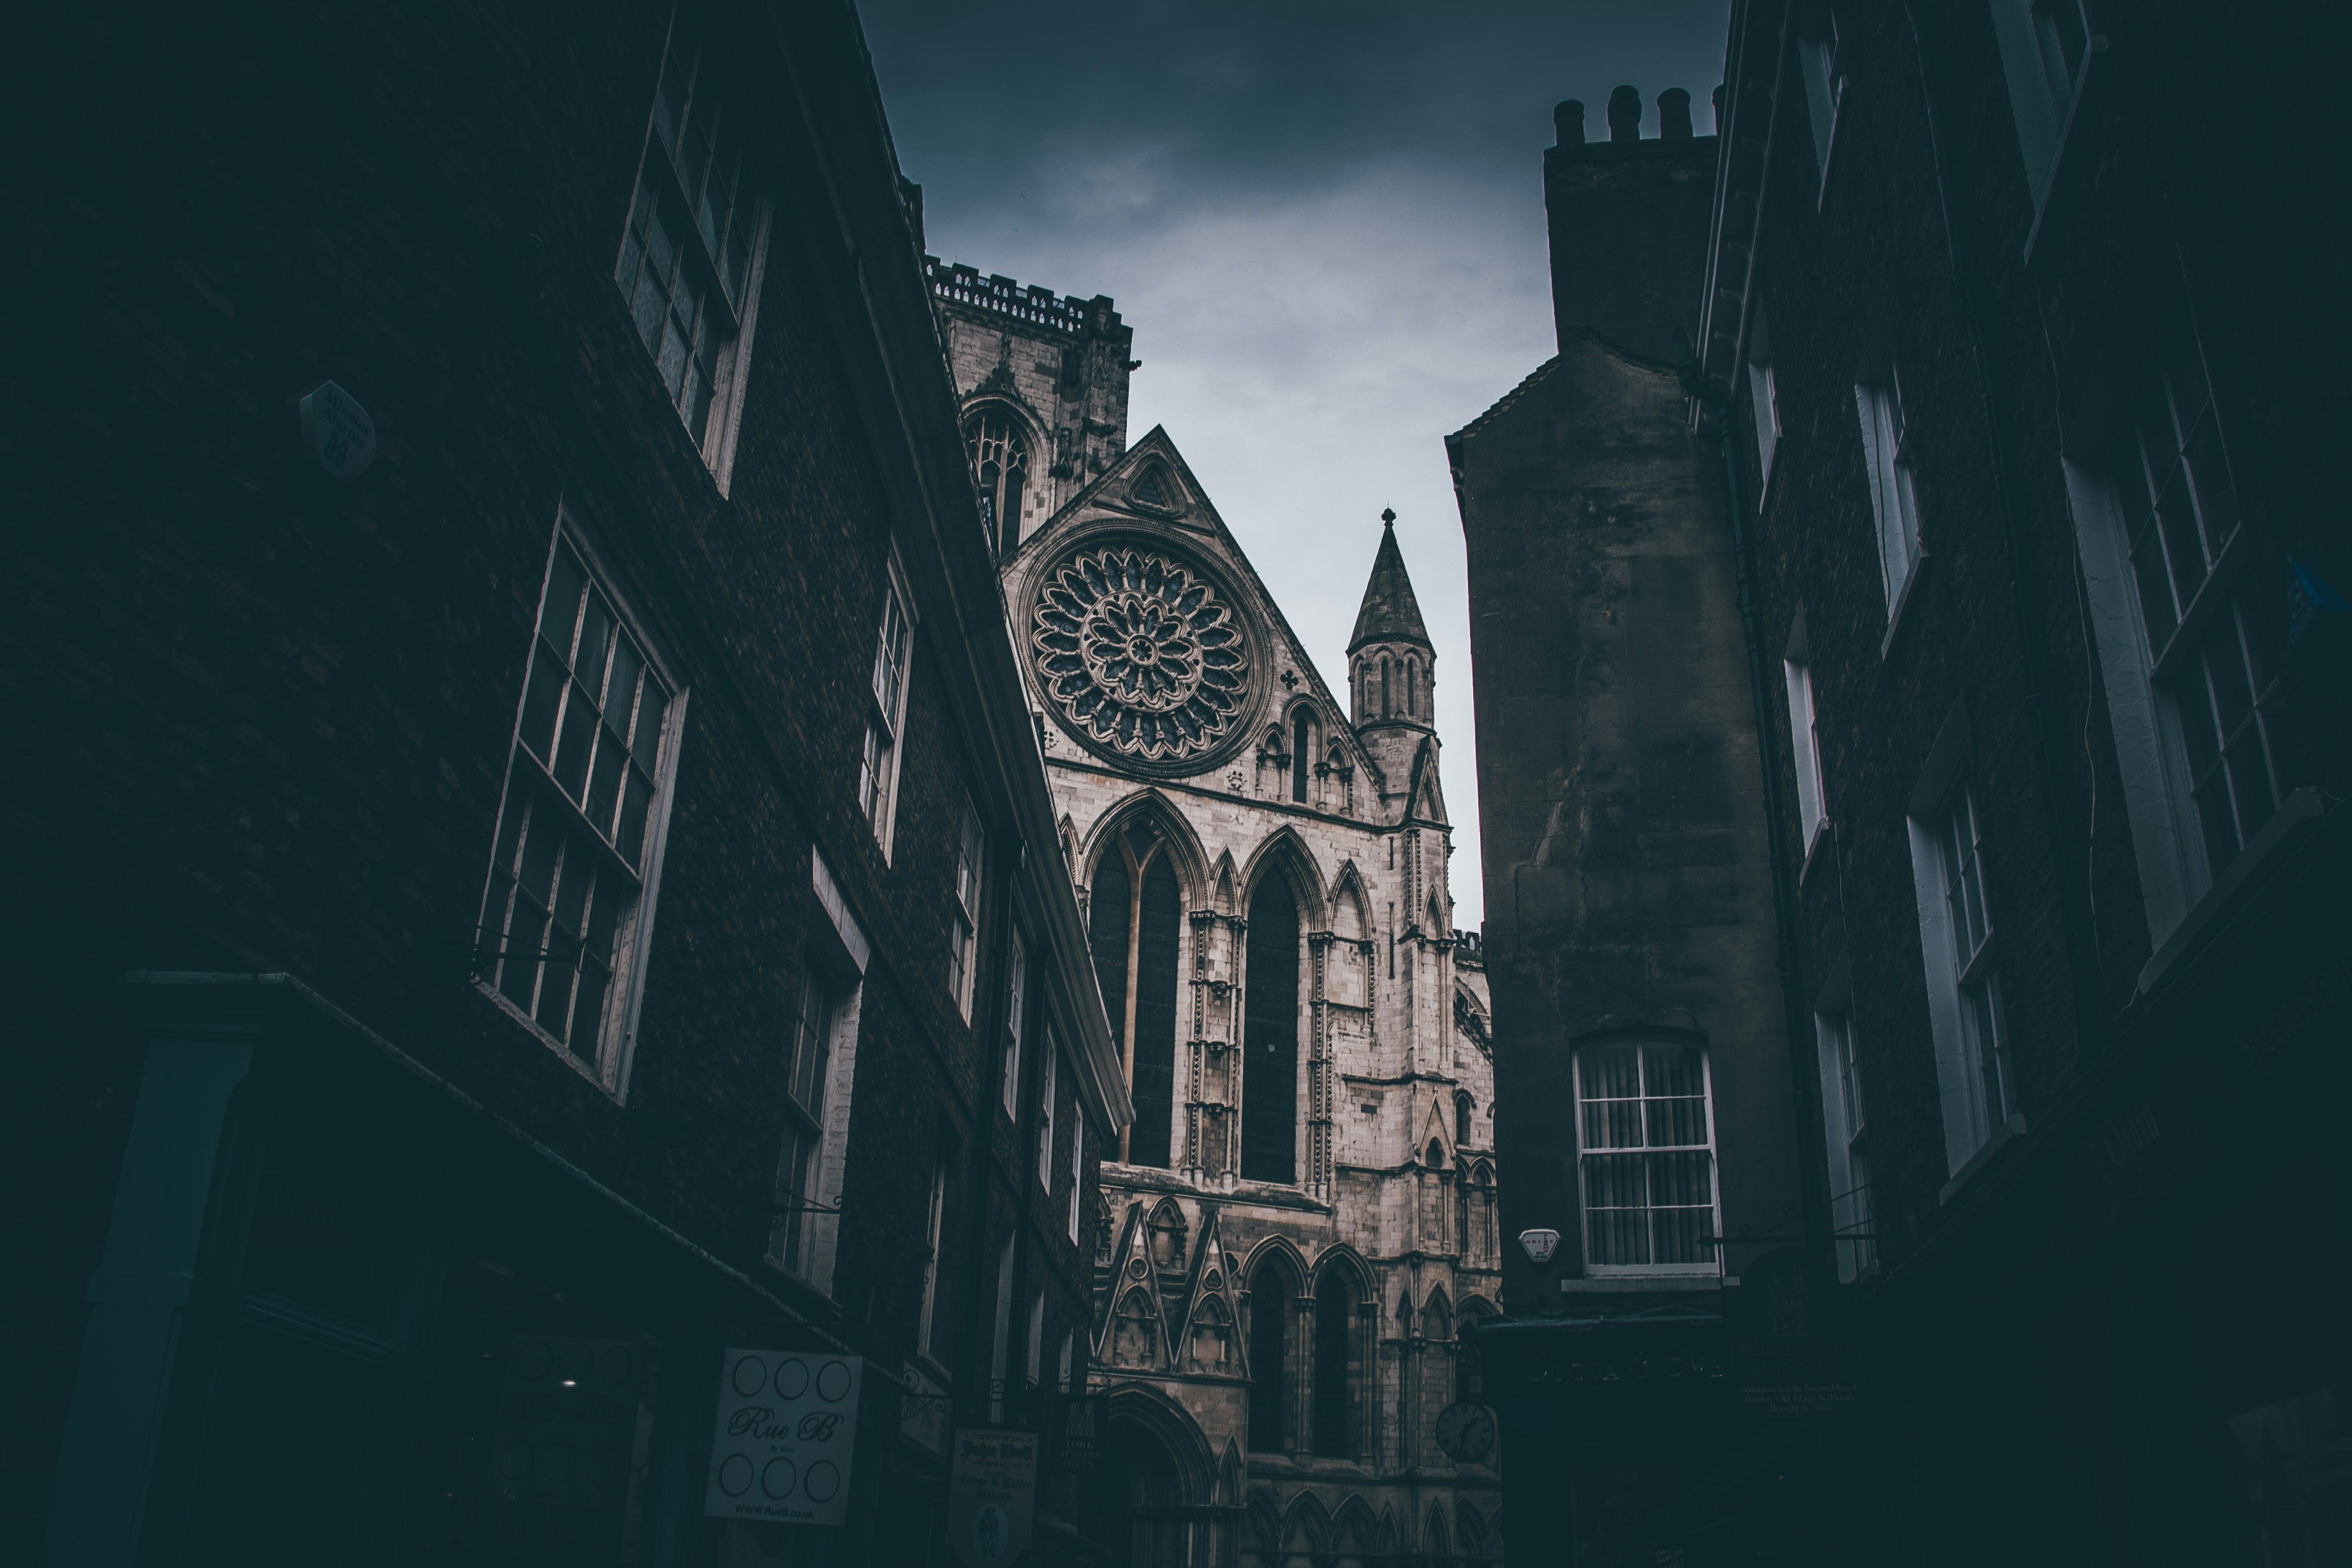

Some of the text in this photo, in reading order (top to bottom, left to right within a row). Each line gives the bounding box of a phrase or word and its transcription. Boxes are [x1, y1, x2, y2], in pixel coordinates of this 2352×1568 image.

[324, 390, 371, 436] Minster
[323, 406, 364, 449] Alarms
[1740, 1384, 1790, 1395] Antiquarian
[727, 1407, 844, 1442] Rue B
[960, 1440, 1034, 1460] John Bull
[1064, 1440, 1095, 1449] YORK
[1055, 1449, 1103, 1459] MINSTER
[957, 1474, 1031, 1490] Fudge & Toffee
[975, 1488, 1011, 1500] Makers
[735, 1504, 814, 1519] WWW.RueB.co.uk
